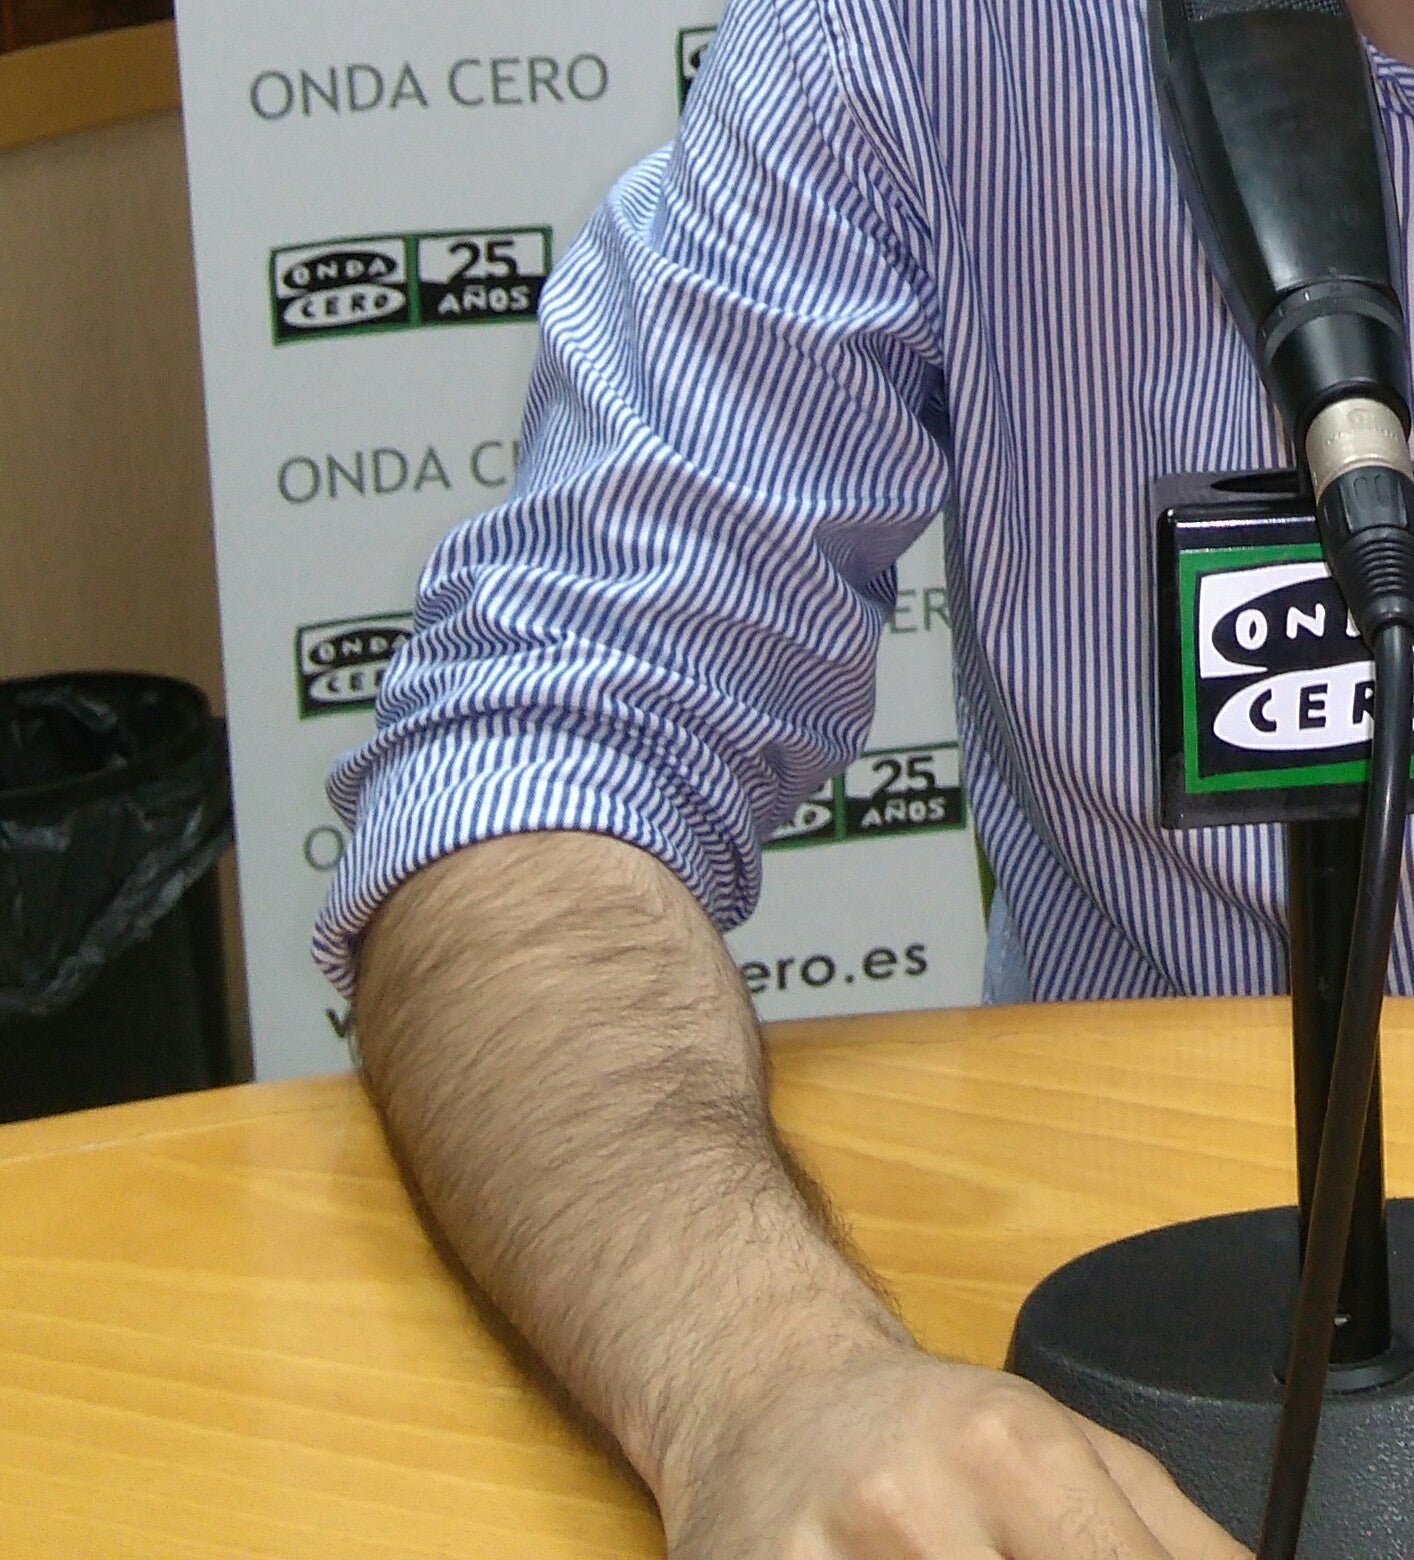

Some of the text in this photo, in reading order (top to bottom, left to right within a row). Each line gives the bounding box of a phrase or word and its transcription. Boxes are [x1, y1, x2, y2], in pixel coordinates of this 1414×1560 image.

[249, 53, 609, 121] ONDA CERO
[292, 257, 388, 287] ONDA
[450, 240, 517, 281] 25
[301, 292, 389, 318] CERO
[438, 284, 530, 315] AÑOS
[278, 445, 452, 504] ONDA
[873, 755, 936, 791] 25
[740, 943, 928, 994] ero.es
